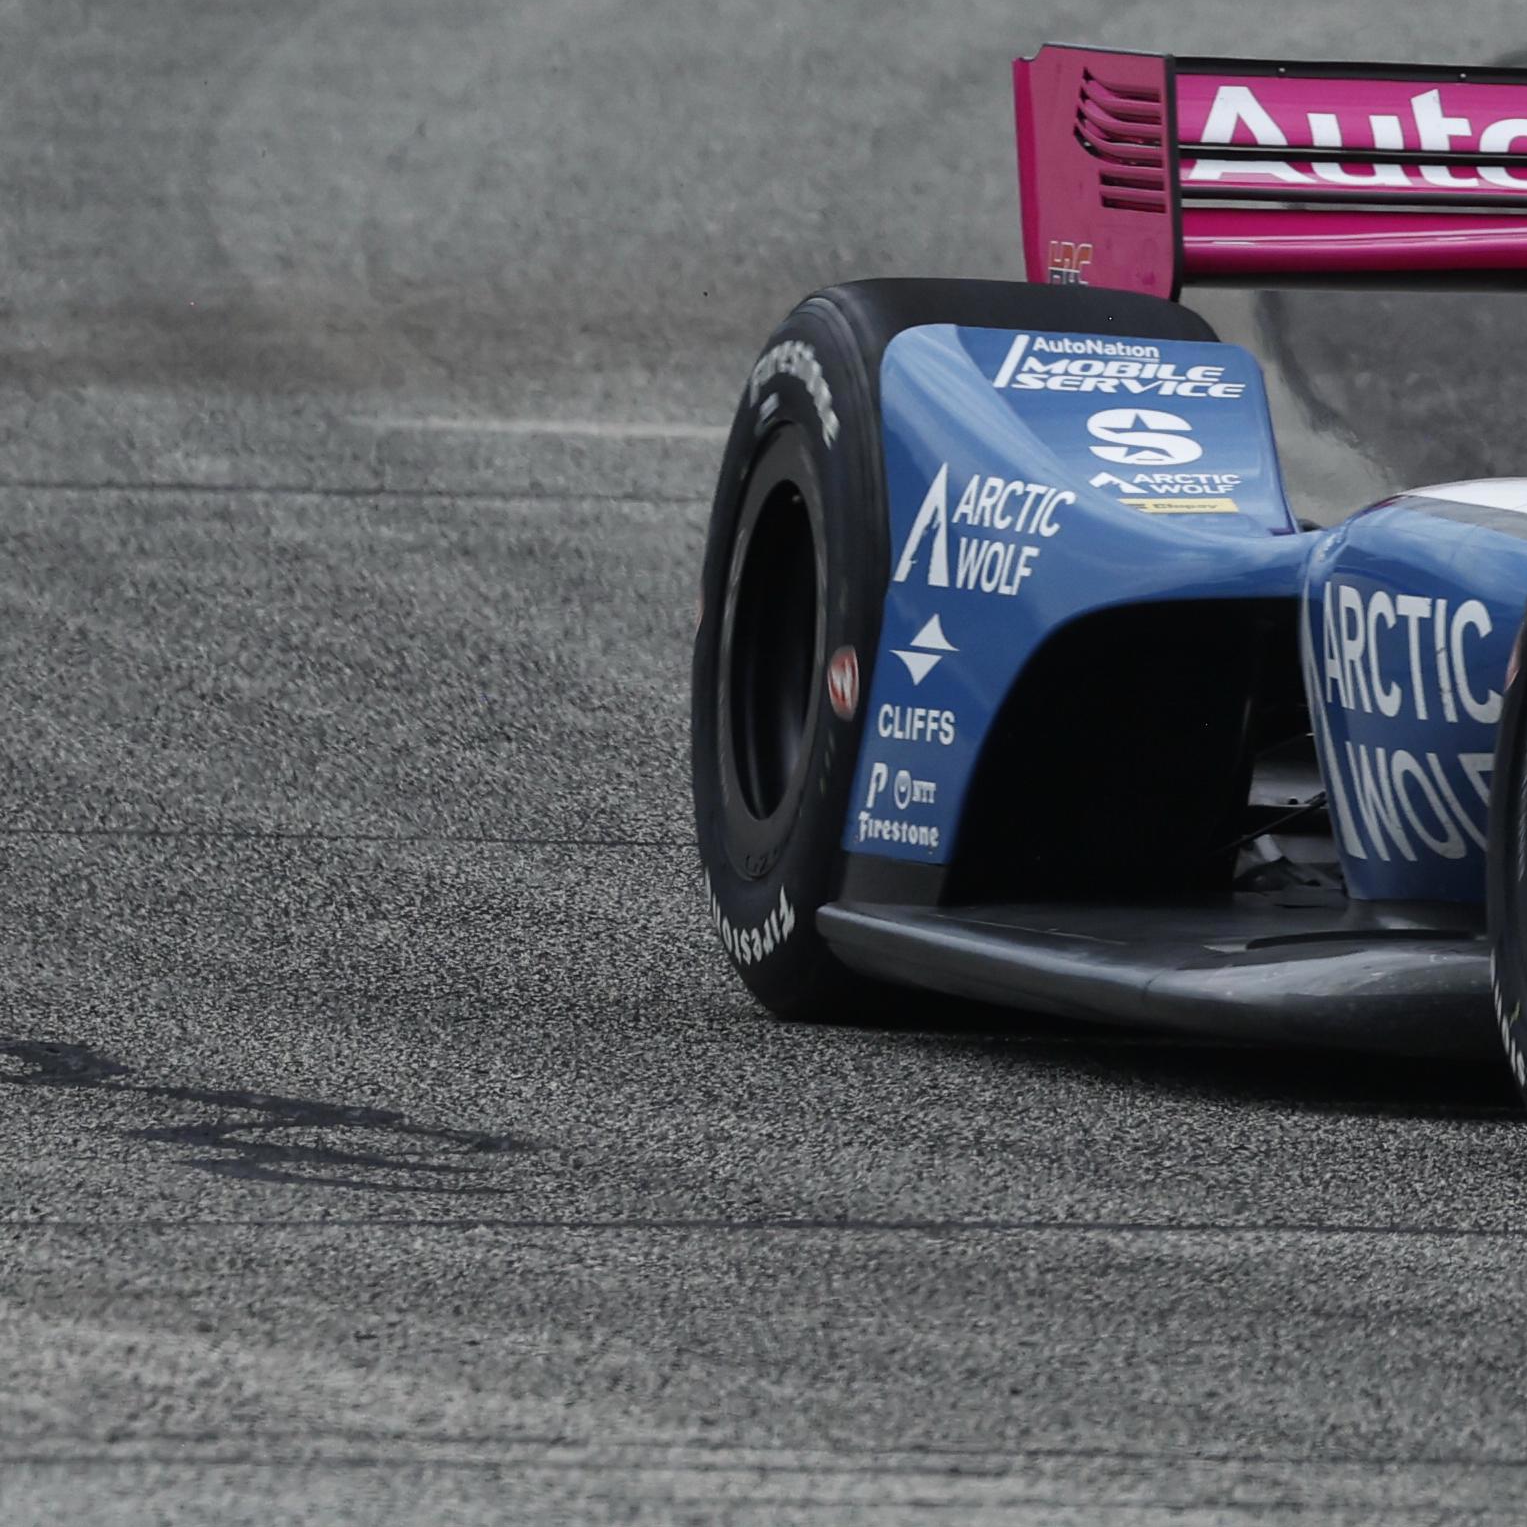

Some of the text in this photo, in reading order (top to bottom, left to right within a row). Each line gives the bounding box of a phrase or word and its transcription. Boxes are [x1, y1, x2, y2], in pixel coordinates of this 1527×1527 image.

[1033, 338, 1160, 359] AutoNation
[1022, 356, 1226, 382] MOBILE
[1011, 373, 1247, 399] SERVICE
[1133, 473, 1242, 485] ARCTIC
[1149, 484, 1235, 494] WOLF
[952, 474, 1077, 538] ARCTIC
[955, 536, 1041, 596] WOLF
[1324, 581, 1504, 724] ARCTIC
[878, 703, 956, 746] CLIFFS
[857, 810, 940, 848] Firestone
